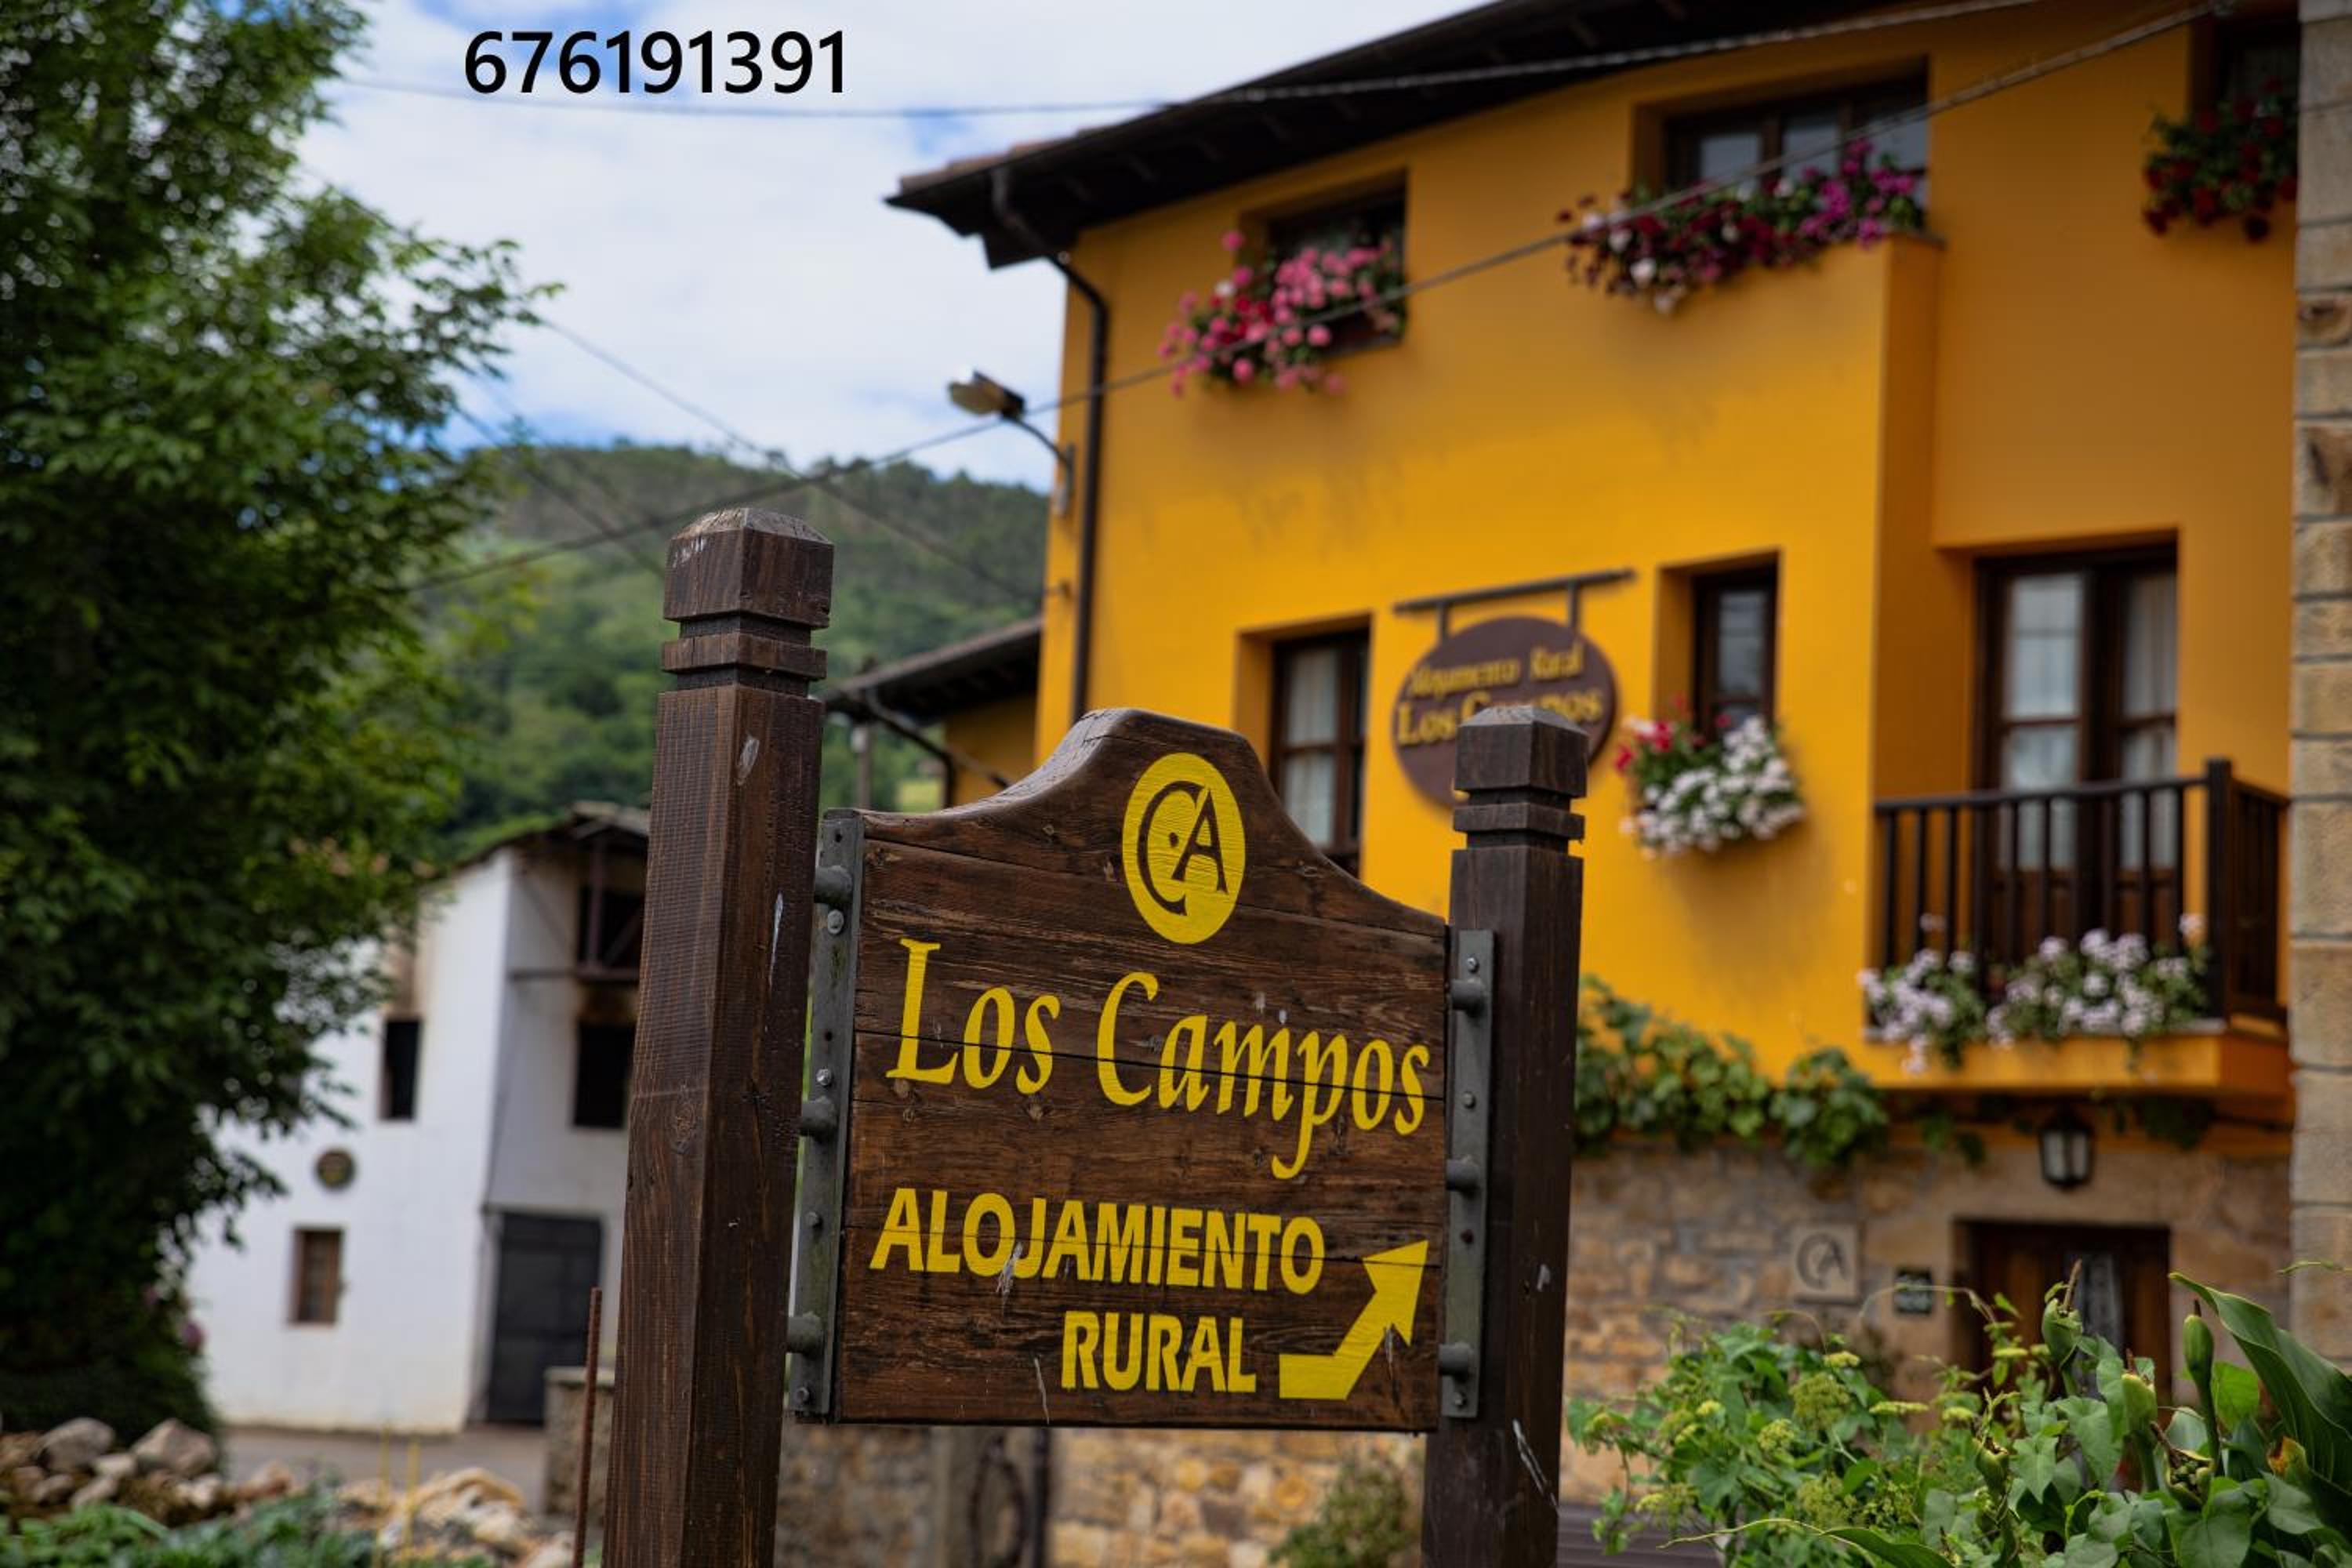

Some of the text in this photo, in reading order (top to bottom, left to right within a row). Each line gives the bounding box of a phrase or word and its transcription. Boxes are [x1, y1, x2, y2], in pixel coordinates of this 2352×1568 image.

[1397, 701, 1457, 746] Los
[887, 939, 1428, 1178] Los Campos
[869, 1187, 1326, 1294] ALOJAMIENTO
[1062, 1312, 1255, 1392] RURAL
